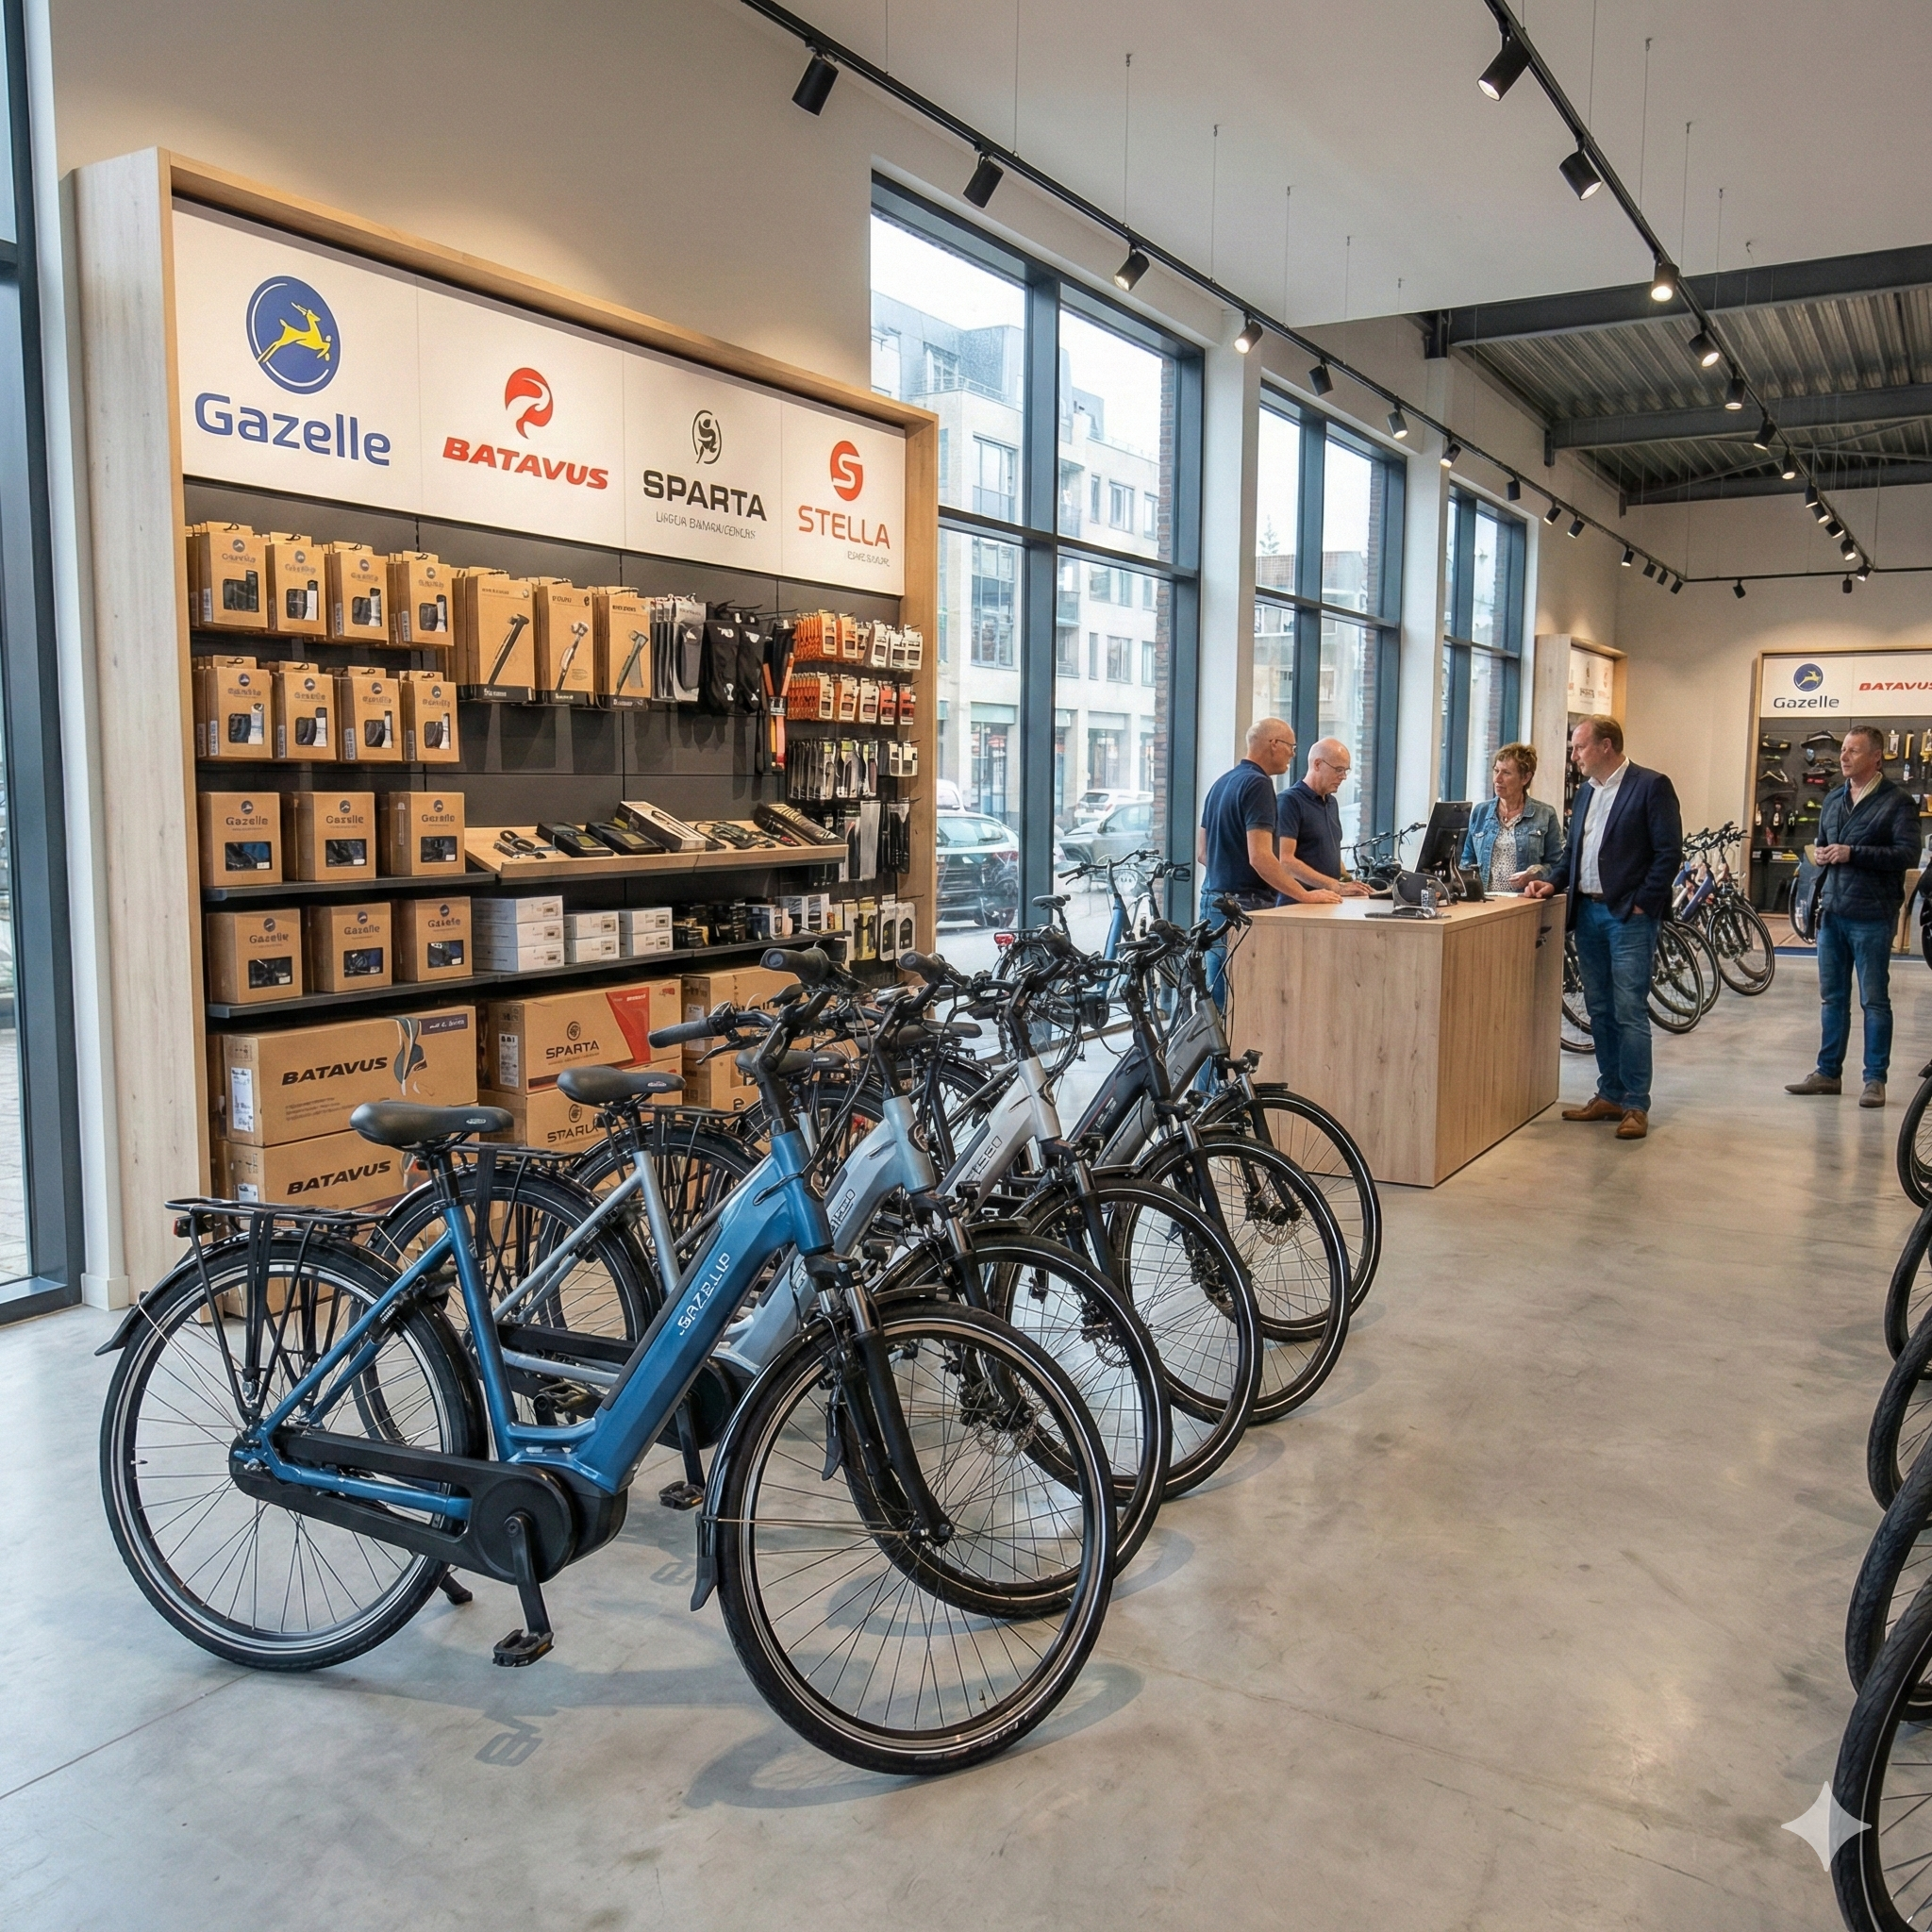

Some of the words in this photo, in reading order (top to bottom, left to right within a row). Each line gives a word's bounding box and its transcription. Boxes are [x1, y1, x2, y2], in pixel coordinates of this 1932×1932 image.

[194, 392, 391, 466] Gazelle
[442, 437, 608, 490] BATAVUS
[643, 470, 767, 522] SPARTA
[798, 505, 891, 549] STELLA
[1774, 695, 1840, 708] Gazelle
[545, 1041, 600, 1059] SPARTA
[282, 1057, 388, 1086] BATAVUS
[287, 1160, 391, 1195] BATAVUS
